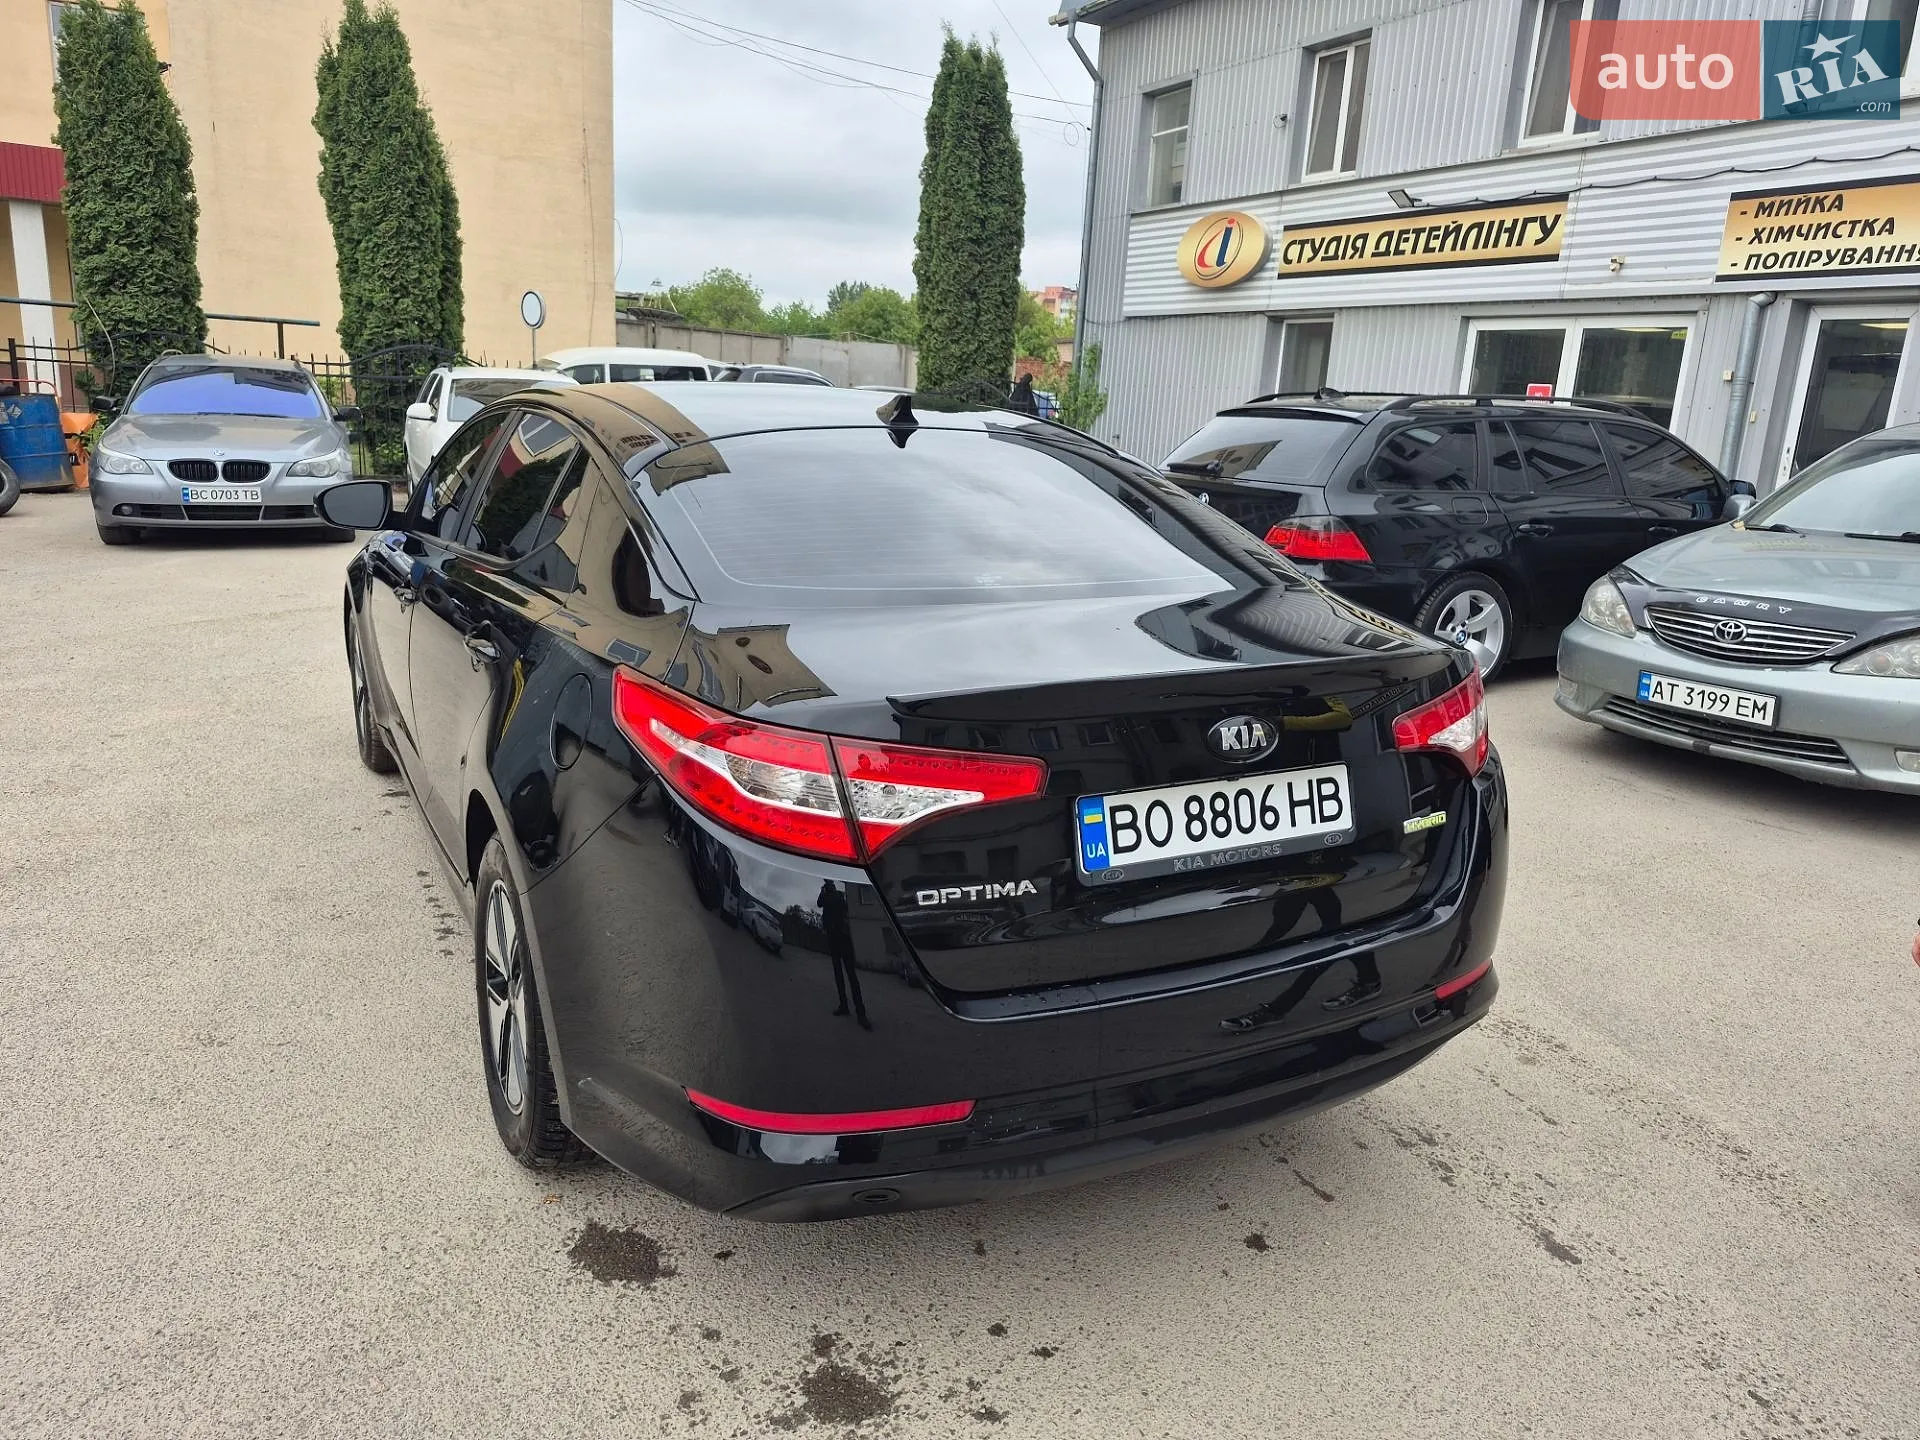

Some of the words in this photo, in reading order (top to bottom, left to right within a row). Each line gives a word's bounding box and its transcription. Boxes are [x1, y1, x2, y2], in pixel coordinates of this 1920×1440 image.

[1753, 193, 1844, 219] МИЙКА
[1282, 232, 1370, 265] СТУДІЯ
[1370, 213, 1562, 258] ДЕТЕЙЛІНГУ
[1748, 216, 1895, 245] ХІМЧИСТКА
[190, 489, 208, 500] BC
[210, 489, 239, 500] 0703
[243, 489, 259, 500] TB
[1651, 680, 1680, 702] AT
[1683, 686, 1730, 713] 3199
[1736, 696, 1768, 721] EM
[1220, 723, 1267, 751] KIA
[1109, 799, 1174, 855] BO
[1184, 784, 1281, 843] 8806
[1286, 775, 1344, 828] HB
[1086, 842, 1106, 859] UA
[1173, 855, 1204, 873] KIA
[1210, 843, 1282, 866] MOTORS
[916, 879, 1038, 906] OPTIMA
